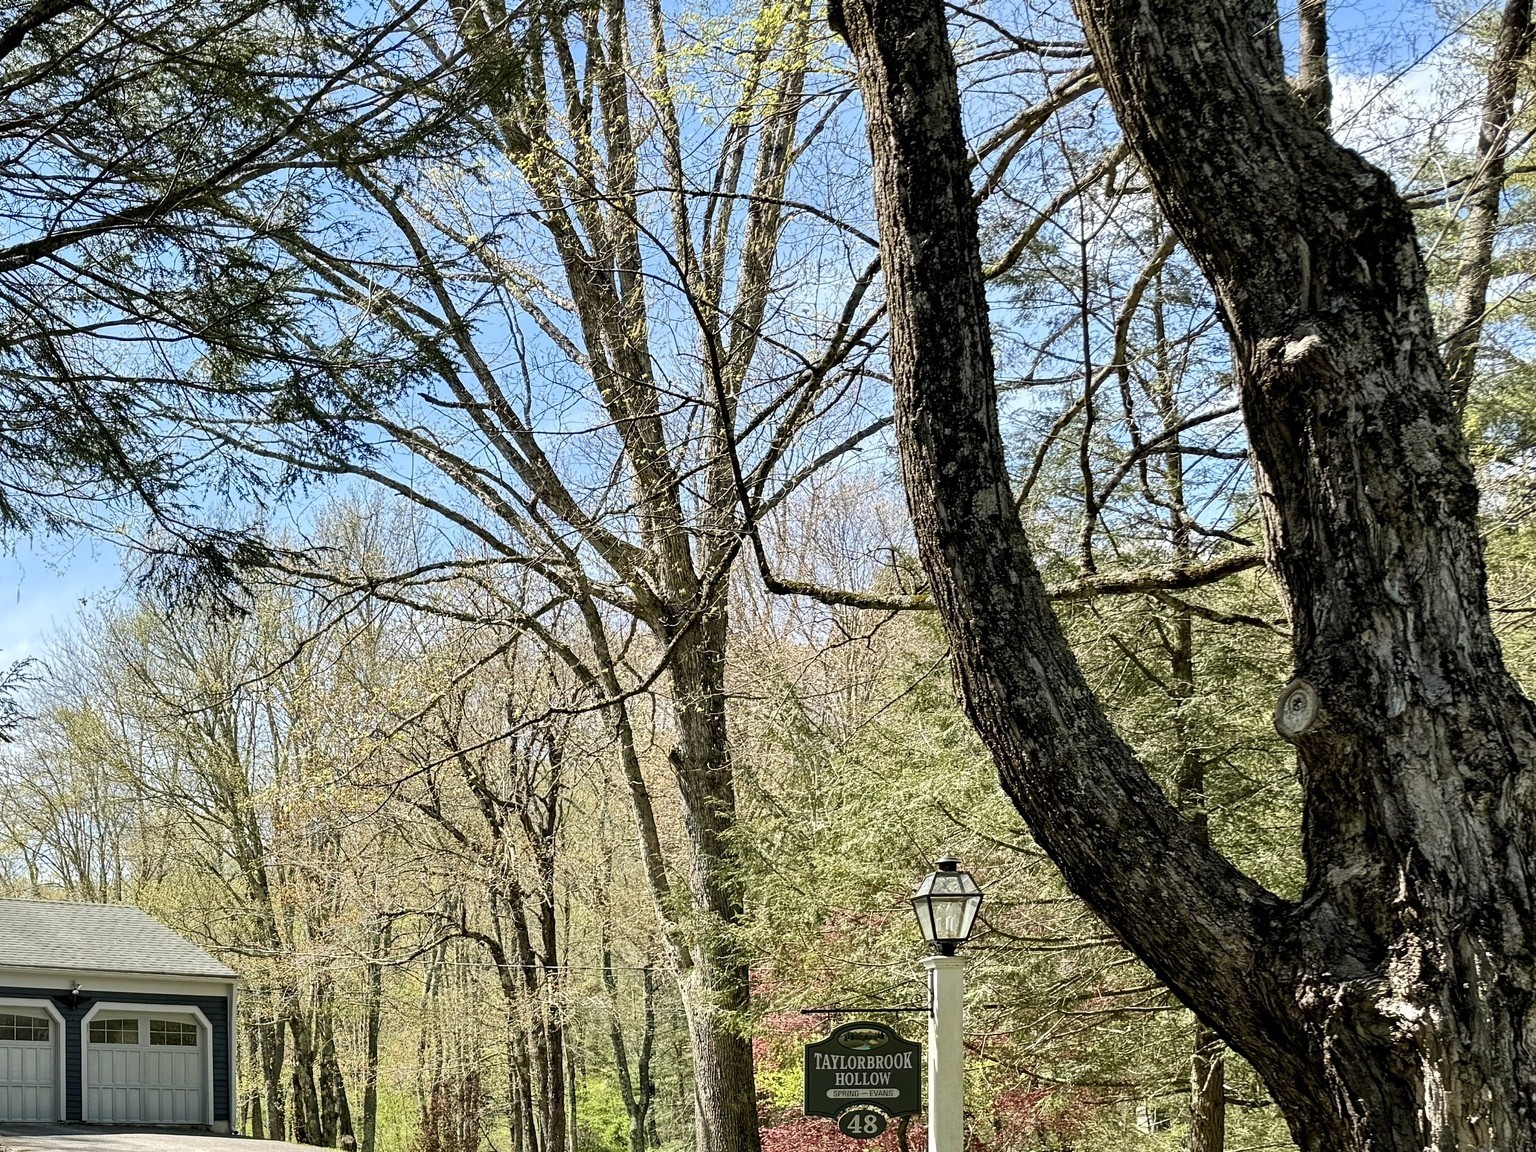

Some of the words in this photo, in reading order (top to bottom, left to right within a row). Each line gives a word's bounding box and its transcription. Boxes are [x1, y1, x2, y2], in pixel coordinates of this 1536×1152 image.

[814, 1051, 913, 1070] TAYLORBROOK
[835, 1072, 892, 1086] HOLLOW
[847, 1114, 878, 1134] 48
